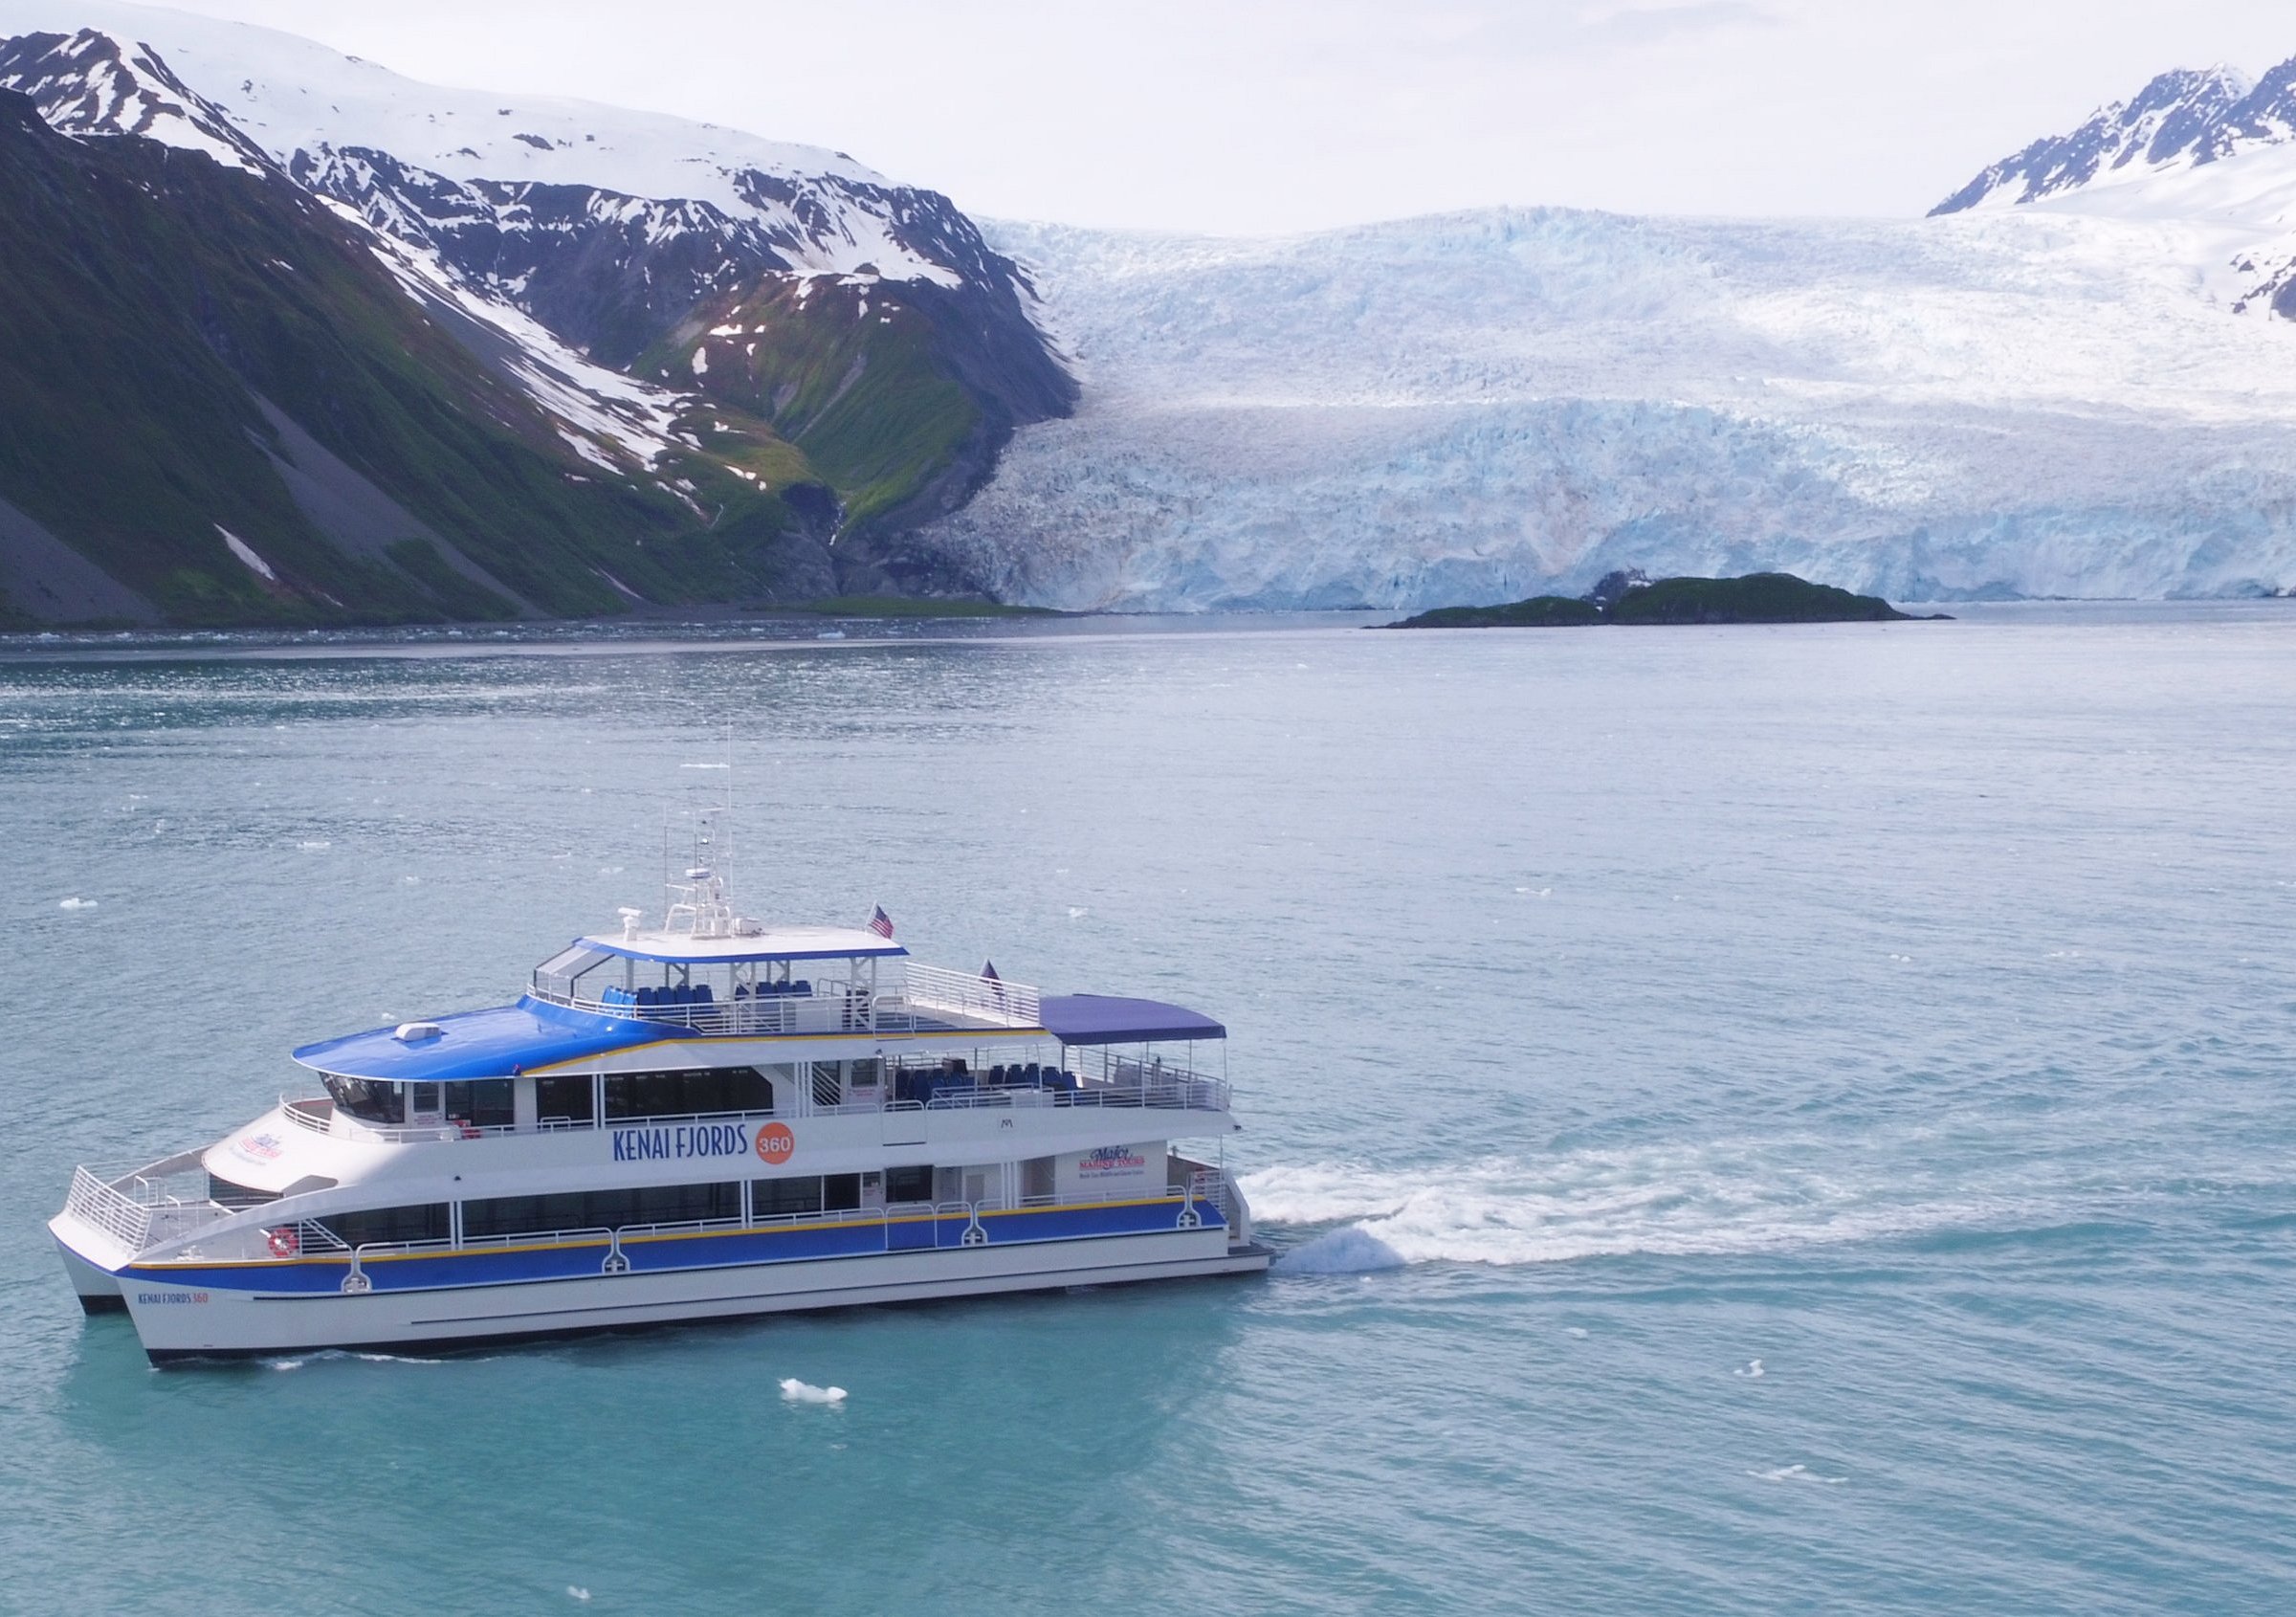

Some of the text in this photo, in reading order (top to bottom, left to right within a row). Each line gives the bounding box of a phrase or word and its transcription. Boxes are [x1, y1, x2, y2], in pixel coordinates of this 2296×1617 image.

[613, 1124, 792, 1161] KENAI FJORDS 360
[138, 1293, 209, 1304] KENAI FJORDS 360
